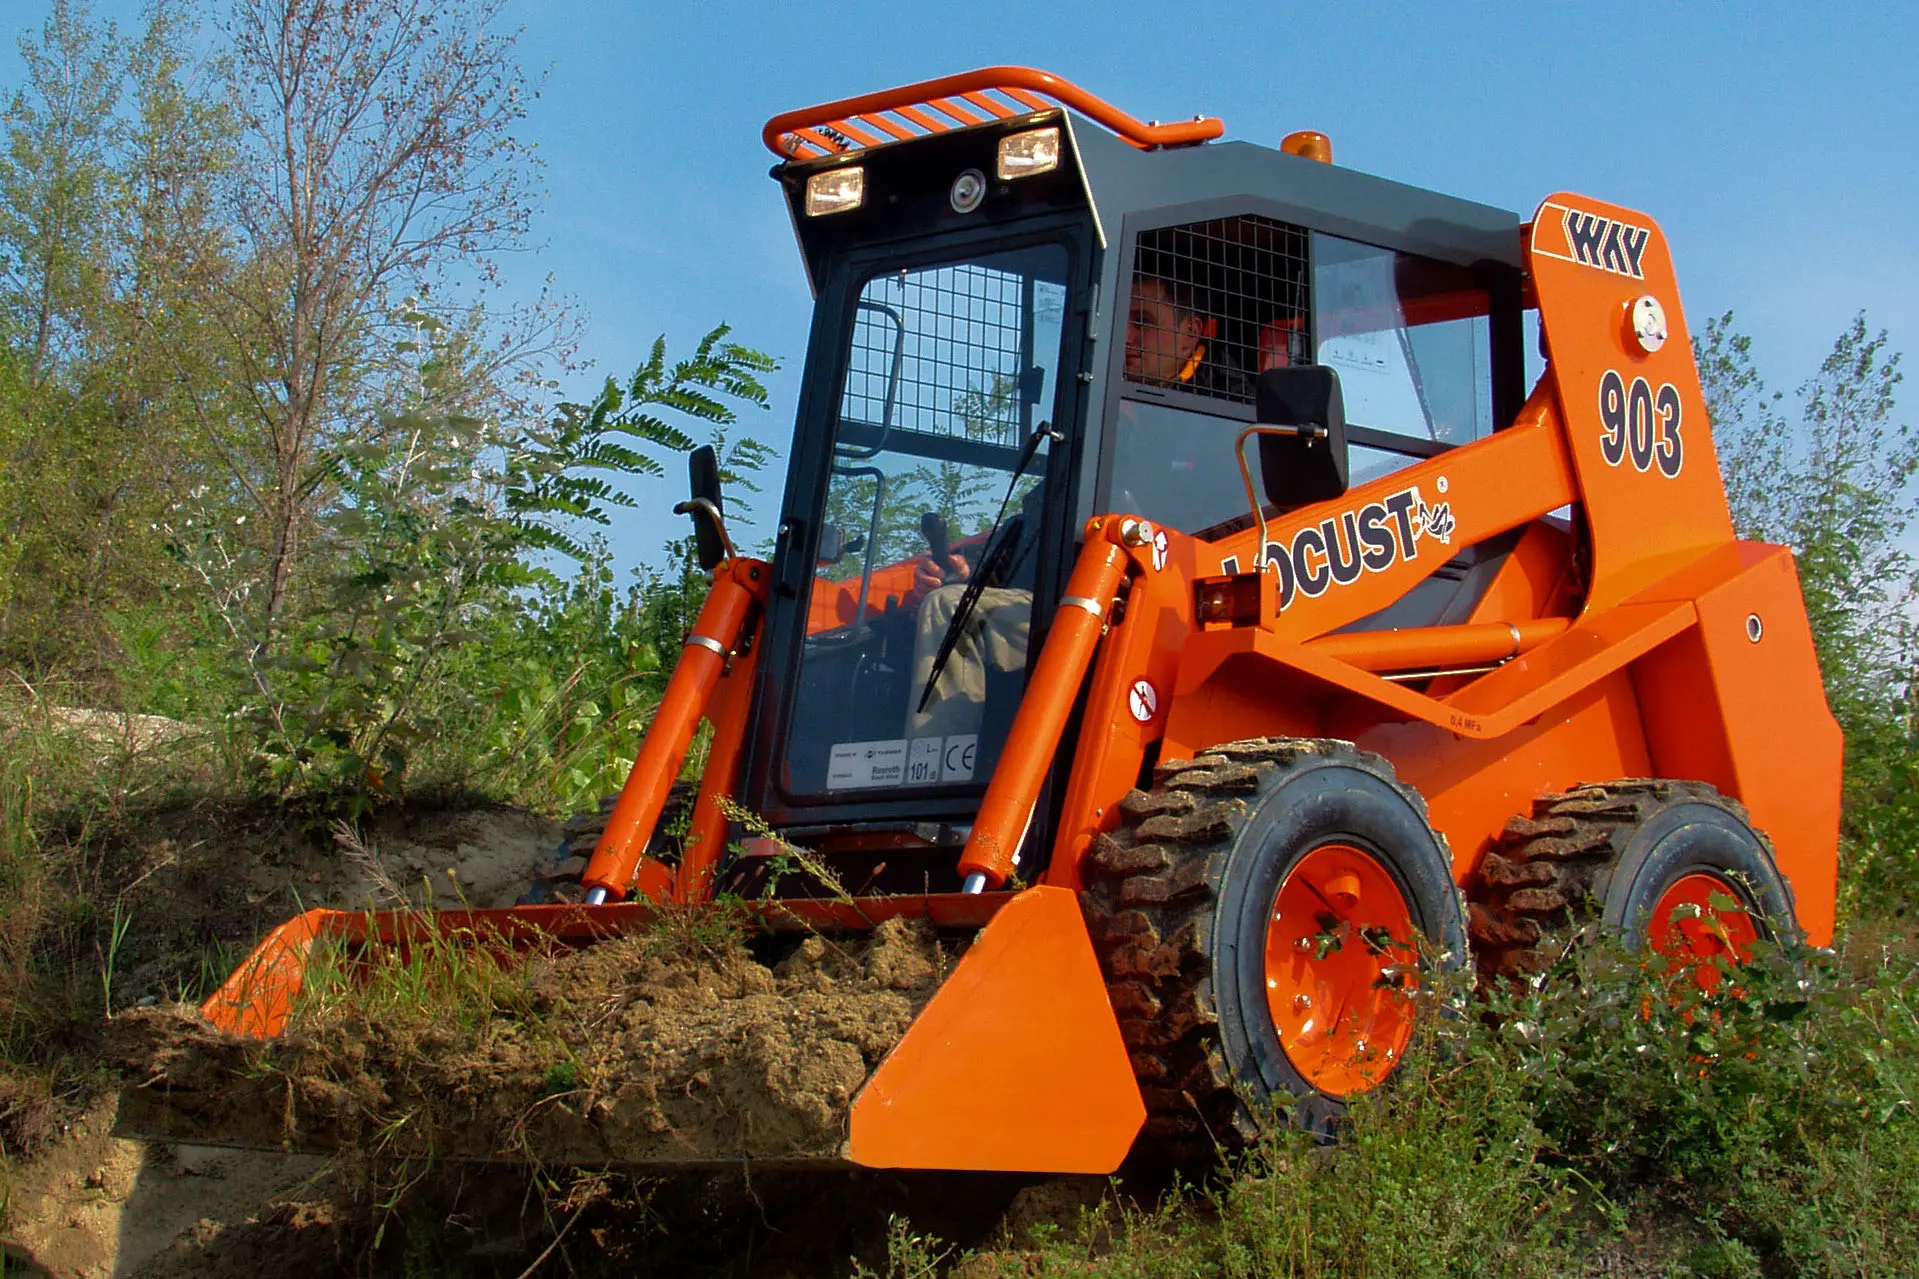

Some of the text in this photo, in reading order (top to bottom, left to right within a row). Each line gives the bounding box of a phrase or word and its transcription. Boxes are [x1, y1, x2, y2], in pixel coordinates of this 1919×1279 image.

[1563, 208, 1650, 281] WAY
[1599, 369, 1684, 480] 903
[1221, 486, 1420, 613] OCUST
[910, 762, 929, 781] 101
